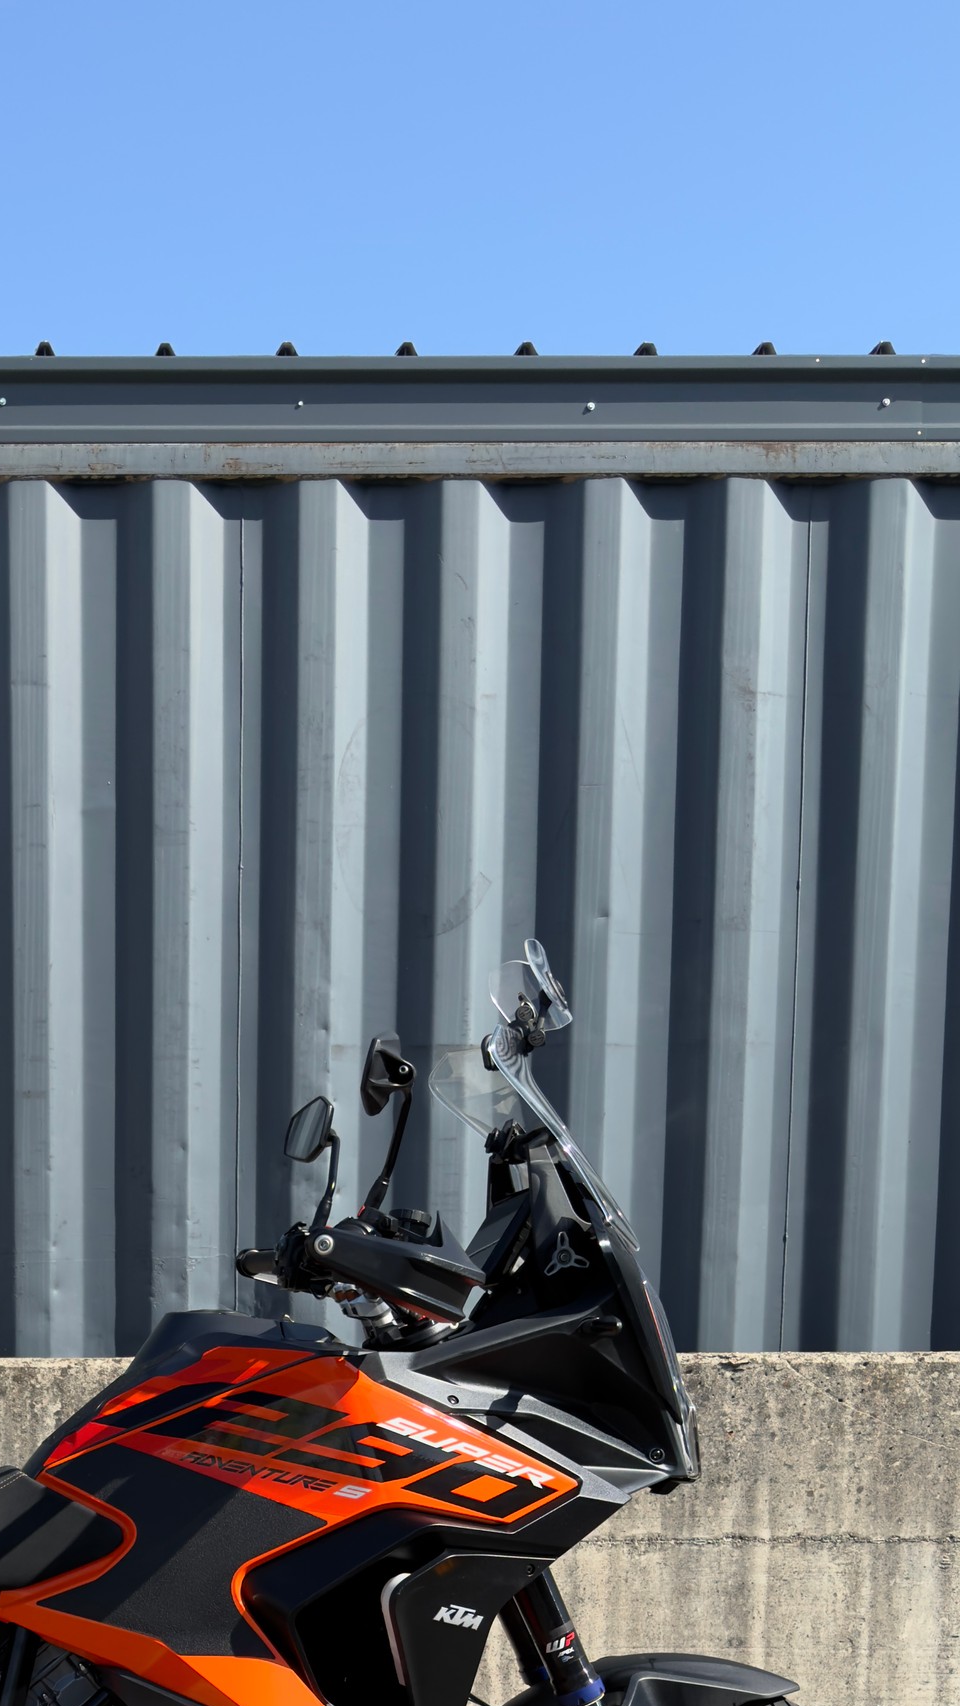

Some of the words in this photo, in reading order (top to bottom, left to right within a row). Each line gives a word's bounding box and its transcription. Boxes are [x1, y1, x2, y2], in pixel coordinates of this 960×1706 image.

[376, 1417, 555, 1489] SUPER
[180, 1451, 338, 1492] ADVENTURE
[332, 1484, 372, 1500] S
[433, 1604, 484, 1631] KTM
[545, 1631, 575, 1653] WP
